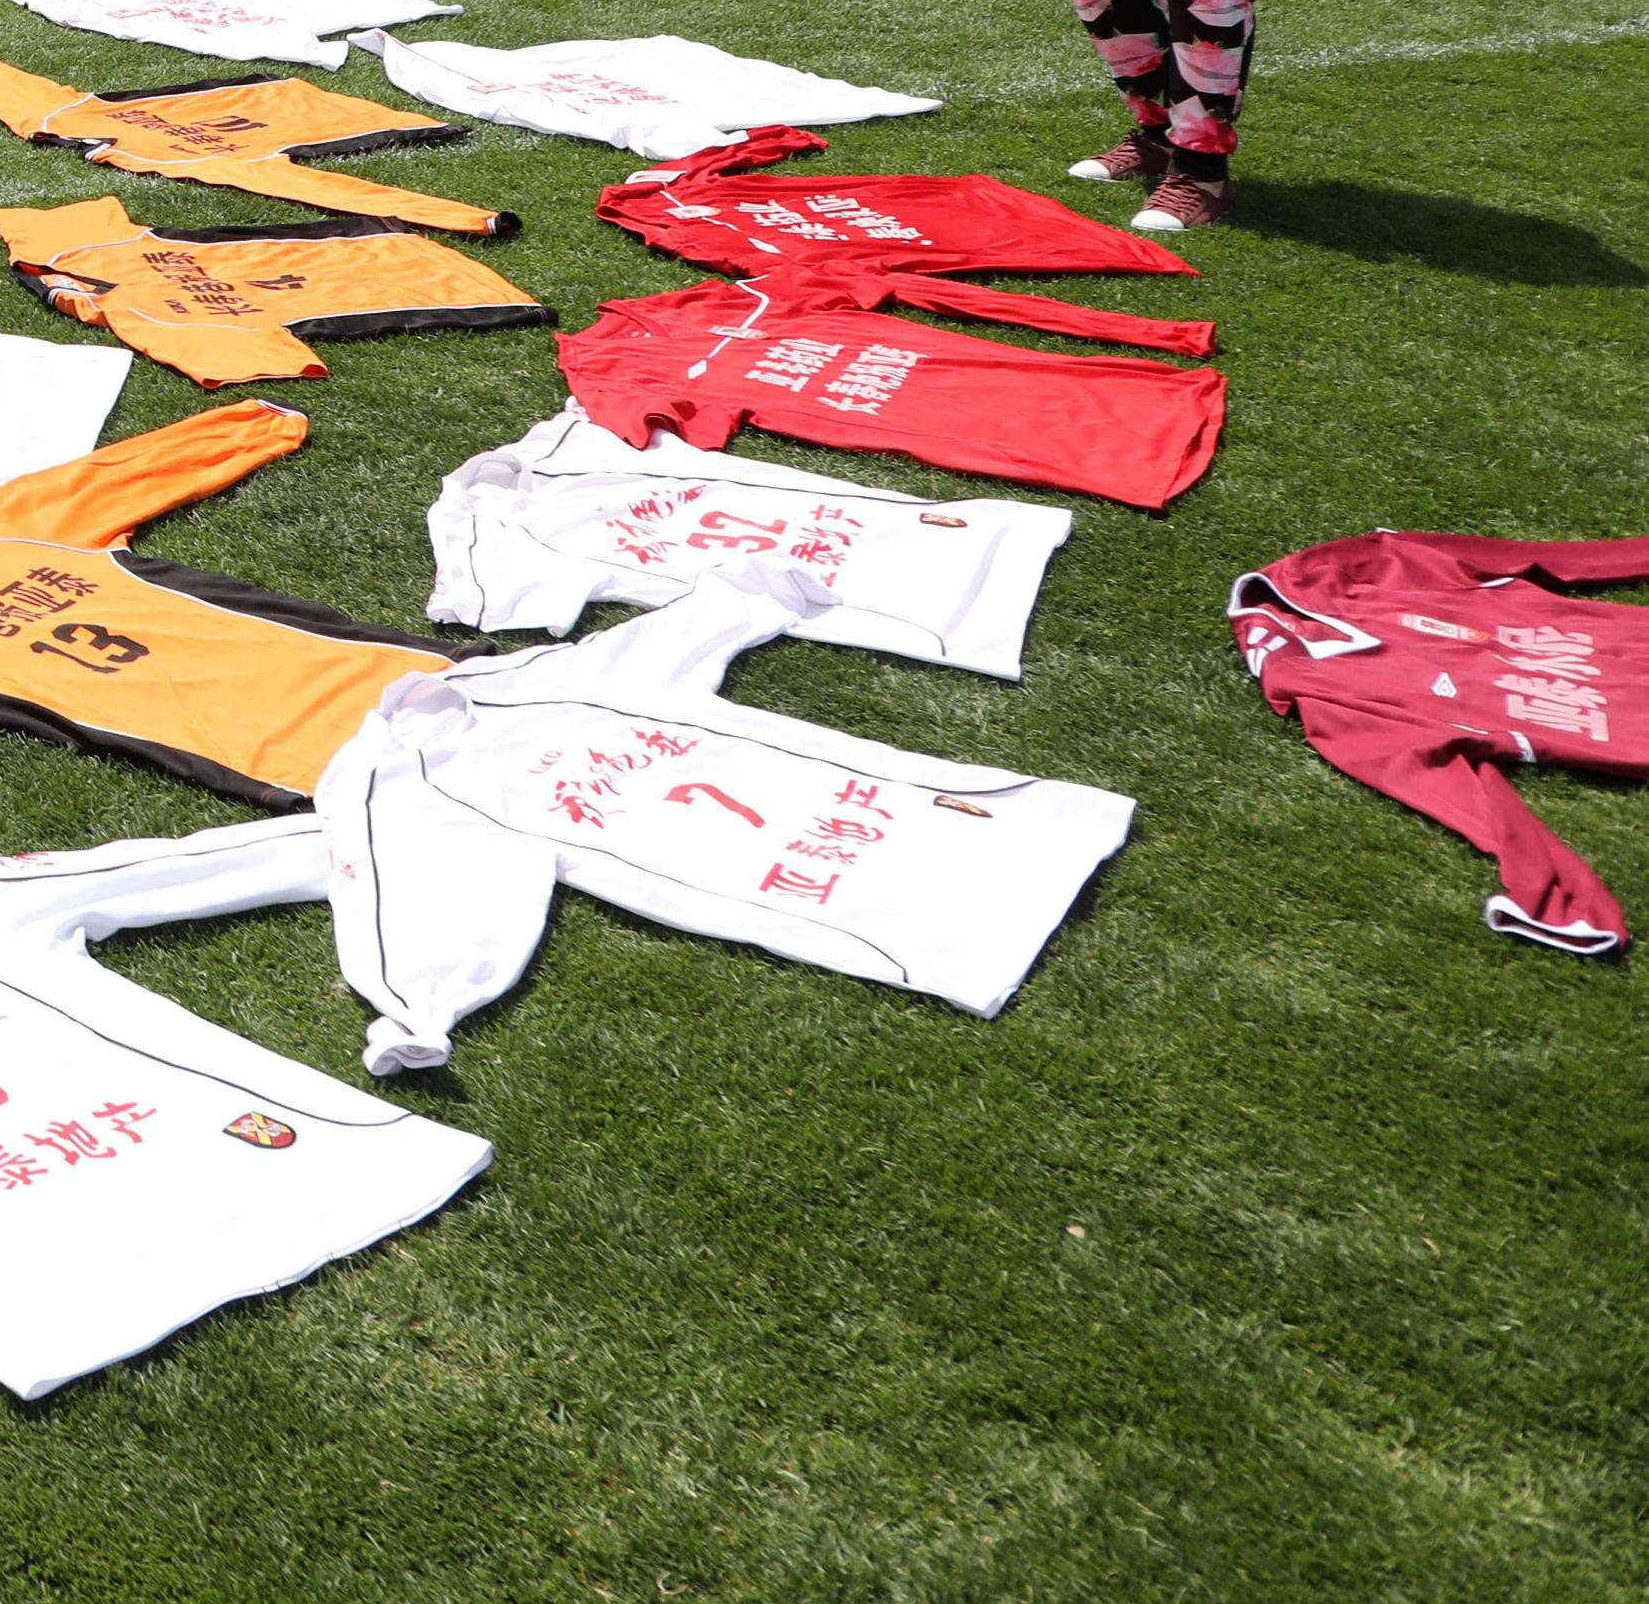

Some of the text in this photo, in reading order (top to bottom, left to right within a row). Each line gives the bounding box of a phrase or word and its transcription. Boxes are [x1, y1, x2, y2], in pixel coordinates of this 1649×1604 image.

[684, 510, 791, 555] 32
[28, 621, 151, 676] 13
[1493, 624, 1611, 743] 亚泰水泥
[664, 782, 768, 829] 7
[758, 779, 900, 907] 亚泰地产
